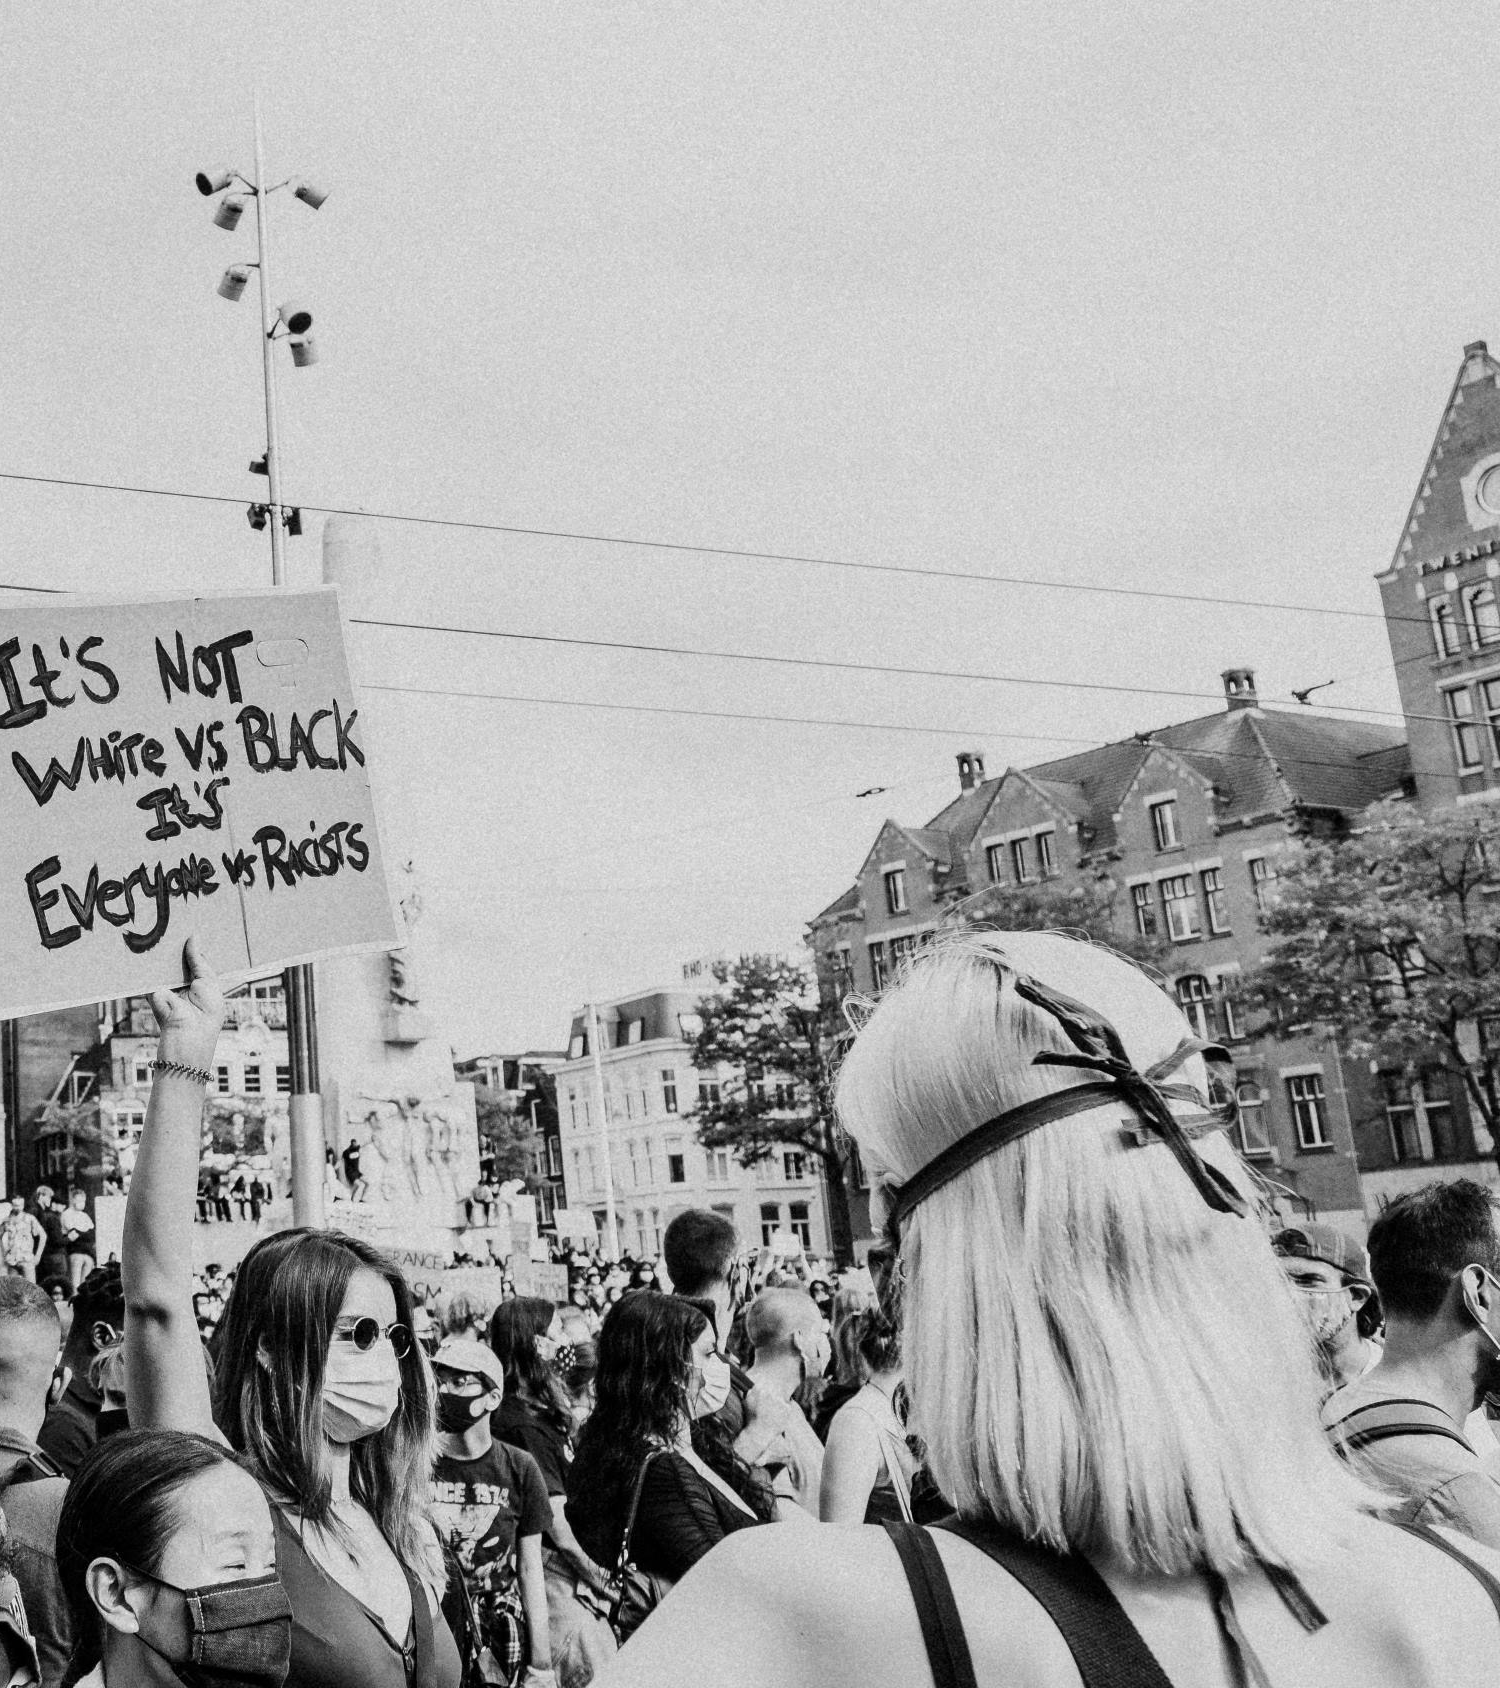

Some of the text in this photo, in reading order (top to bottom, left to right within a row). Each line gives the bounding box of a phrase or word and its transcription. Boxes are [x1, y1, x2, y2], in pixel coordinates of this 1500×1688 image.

[155, 630, 253, 704] NOT
[236, 698, 366, 773] BLACK
[426, 1481, 466, 1504] NCE
